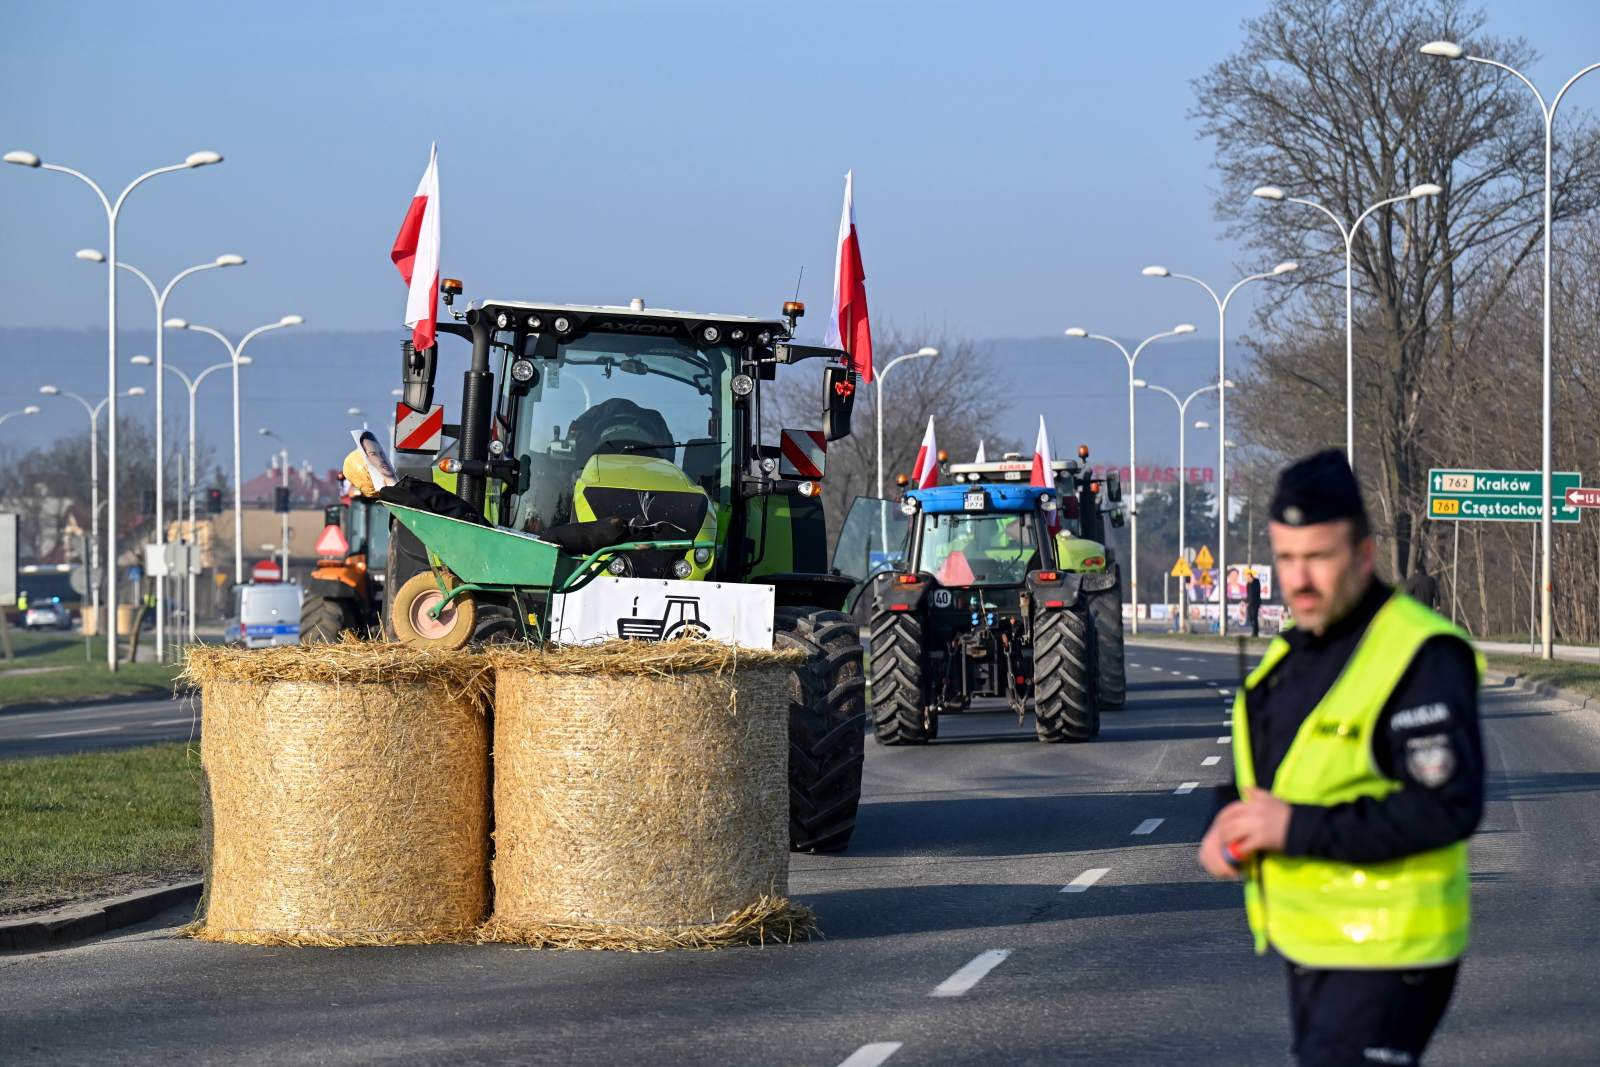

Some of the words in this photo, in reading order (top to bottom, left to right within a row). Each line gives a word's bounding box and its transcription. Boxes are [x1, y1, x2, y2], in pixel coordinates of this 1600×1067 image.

[1448, 478, 1468, 488] 762
[1476, 477, 1530, 491] Kraków
[1437, 502, 1455, 512] 761
[936, 592, 948, 604] 40
